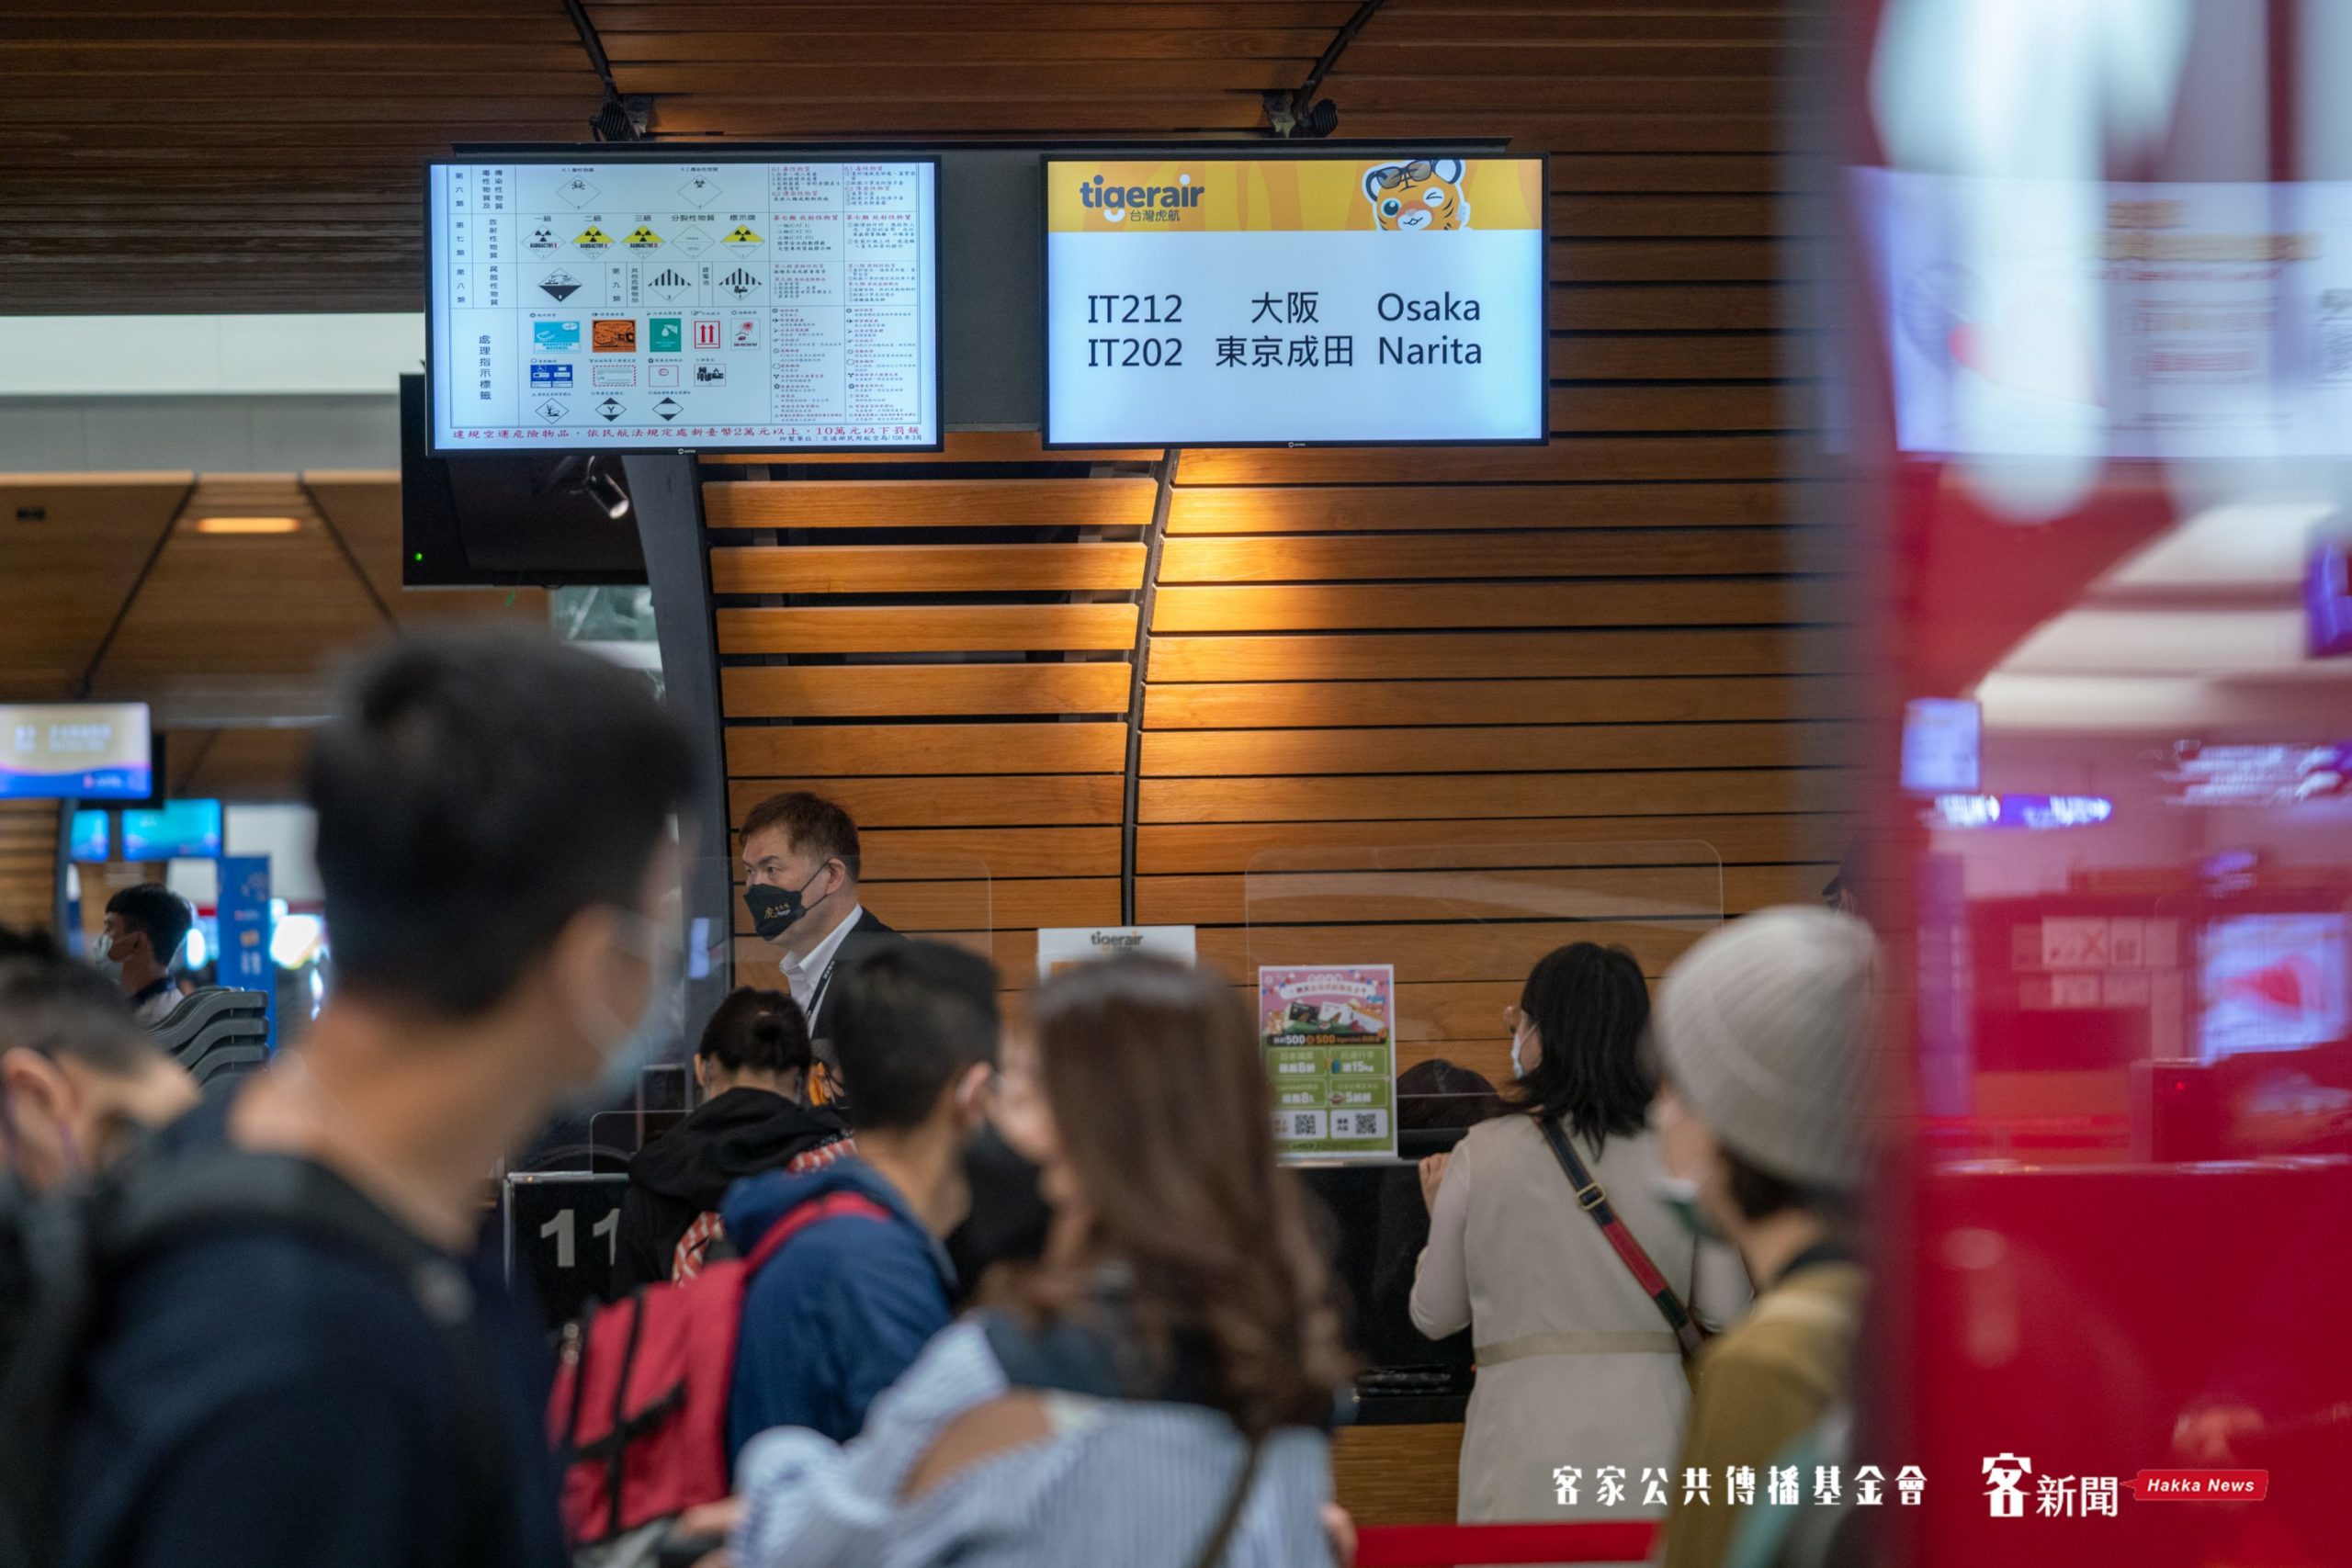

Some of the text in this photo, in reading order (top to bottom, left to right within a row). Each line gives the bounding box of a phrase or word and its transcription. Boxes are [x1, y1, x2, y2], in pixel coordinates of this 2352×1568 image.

[455, 172, 464, 208] 第六類
[1080, 173, 1205, 222] tigerair
[671, 214, 715, 222] 分裂性物質
[1129, 209, 1181, 222] 台灣虎航
[456, 221, 465, 256] 第七類
[489, 219, 498, 259] 放射性物質
[457, 269, 466, 303] 第八類
[1088, 290, 1481, 324] IT212 大阪 Osaka
[478, 334, 492, 401] 處理指示標籤
[1088, 334, 1483, 368] IT202 東京成田 Narita
[606, 406, 616, 414] Y
[1091, 931, 1144, 952] tigerair
